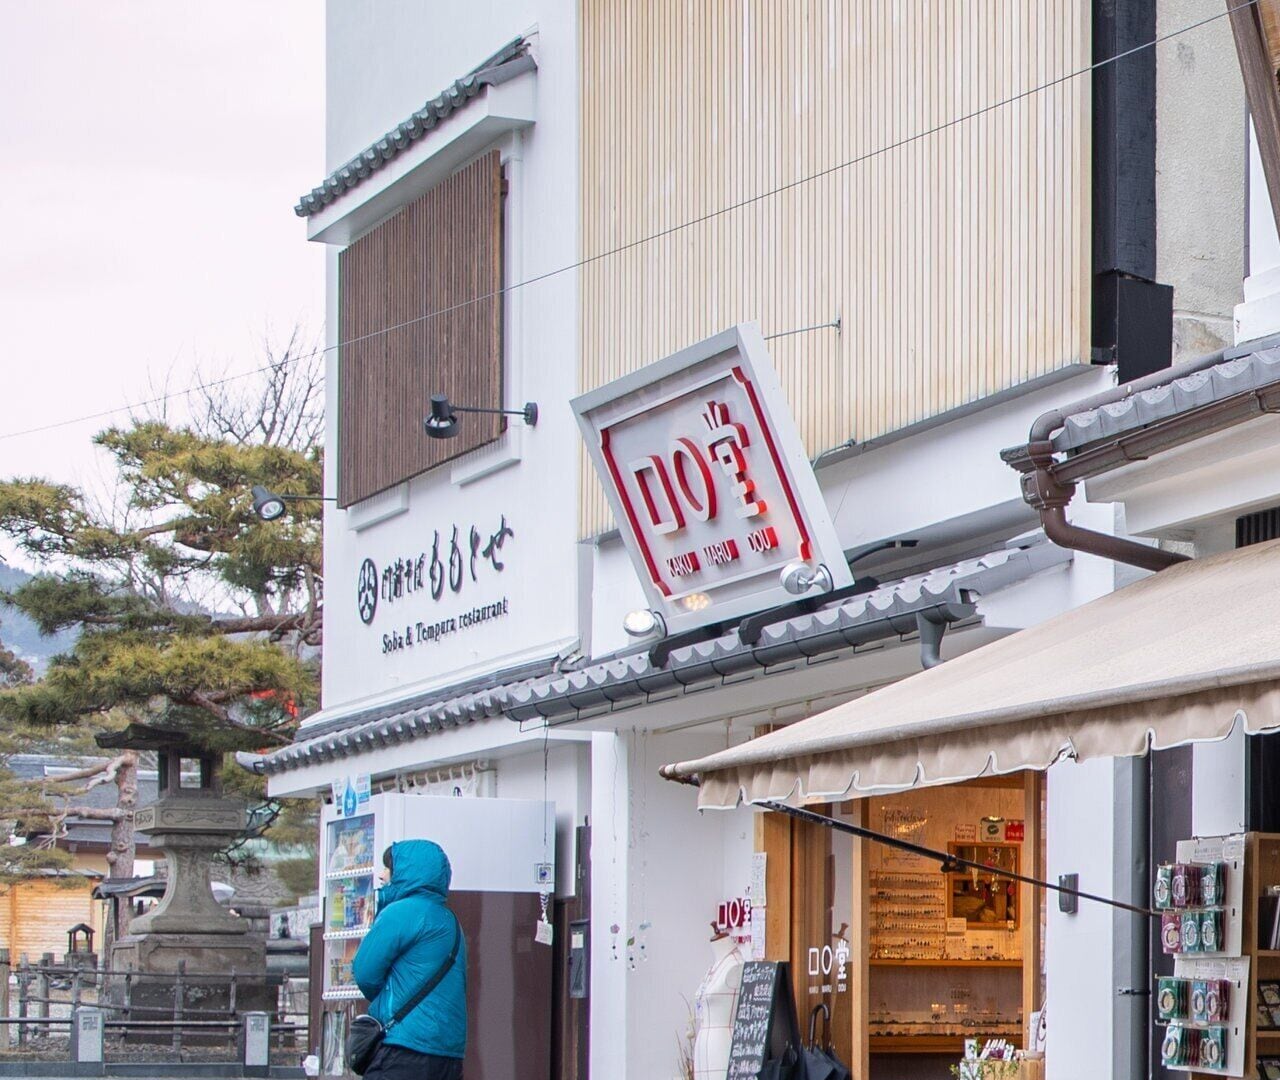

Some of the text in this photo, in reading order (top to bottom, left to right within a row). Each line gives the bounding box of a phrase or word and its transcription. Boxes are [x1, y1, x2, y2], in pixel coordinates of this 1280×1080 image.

[666, 527, 778, 578] KAKU MARU DOU
[382, 596, 508, 654] Soba & Tempura restaurant
